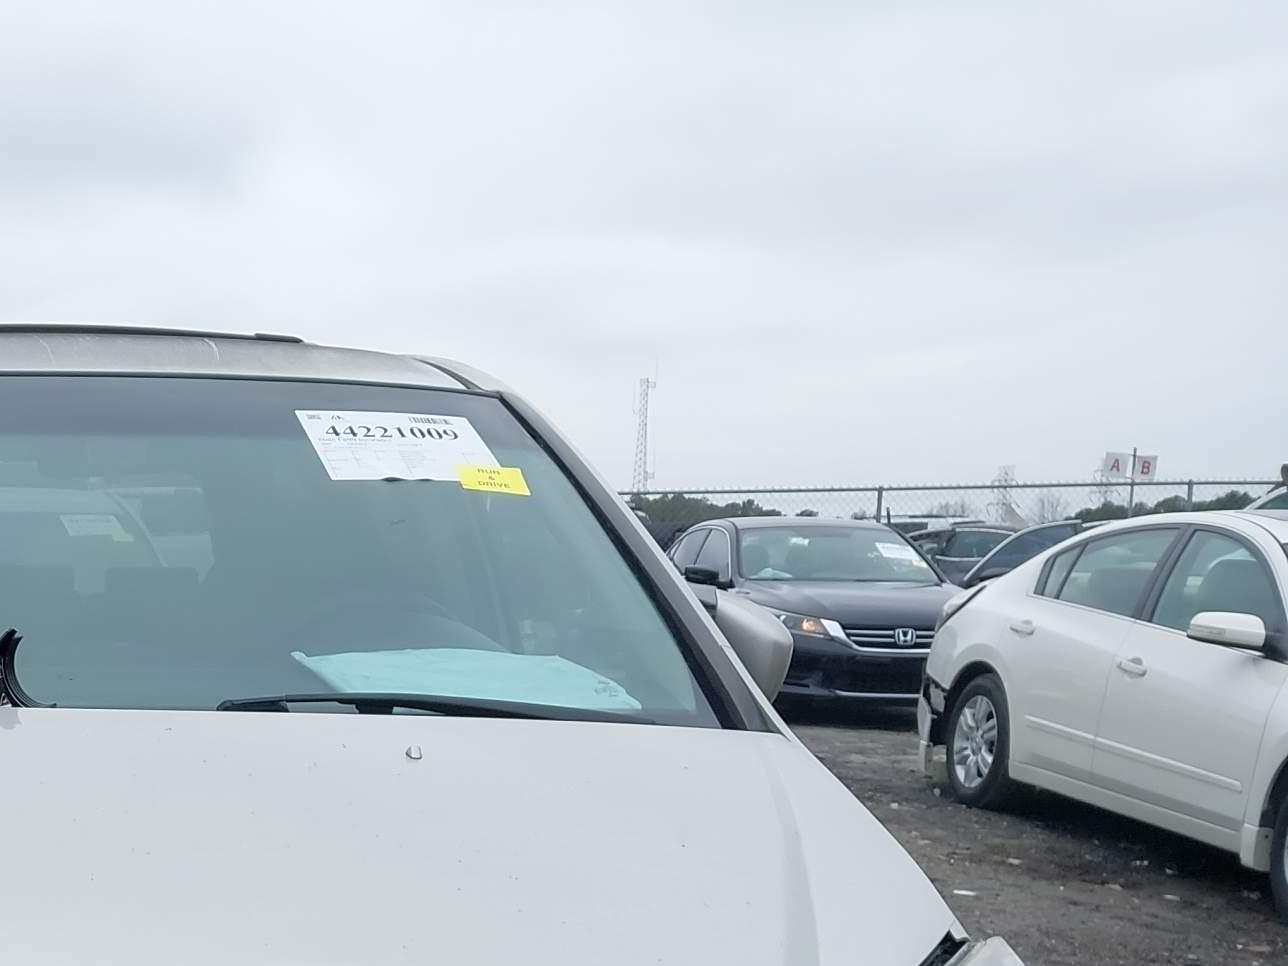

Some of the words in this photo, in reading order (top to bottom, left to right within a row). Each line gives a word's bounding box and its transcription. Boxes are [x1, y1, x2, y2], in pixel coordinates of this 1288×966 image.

[325, 424, 460, 441] 44221009
[1110, 457, 1120, 472] A
[1140, 460, 1151, 475] B
